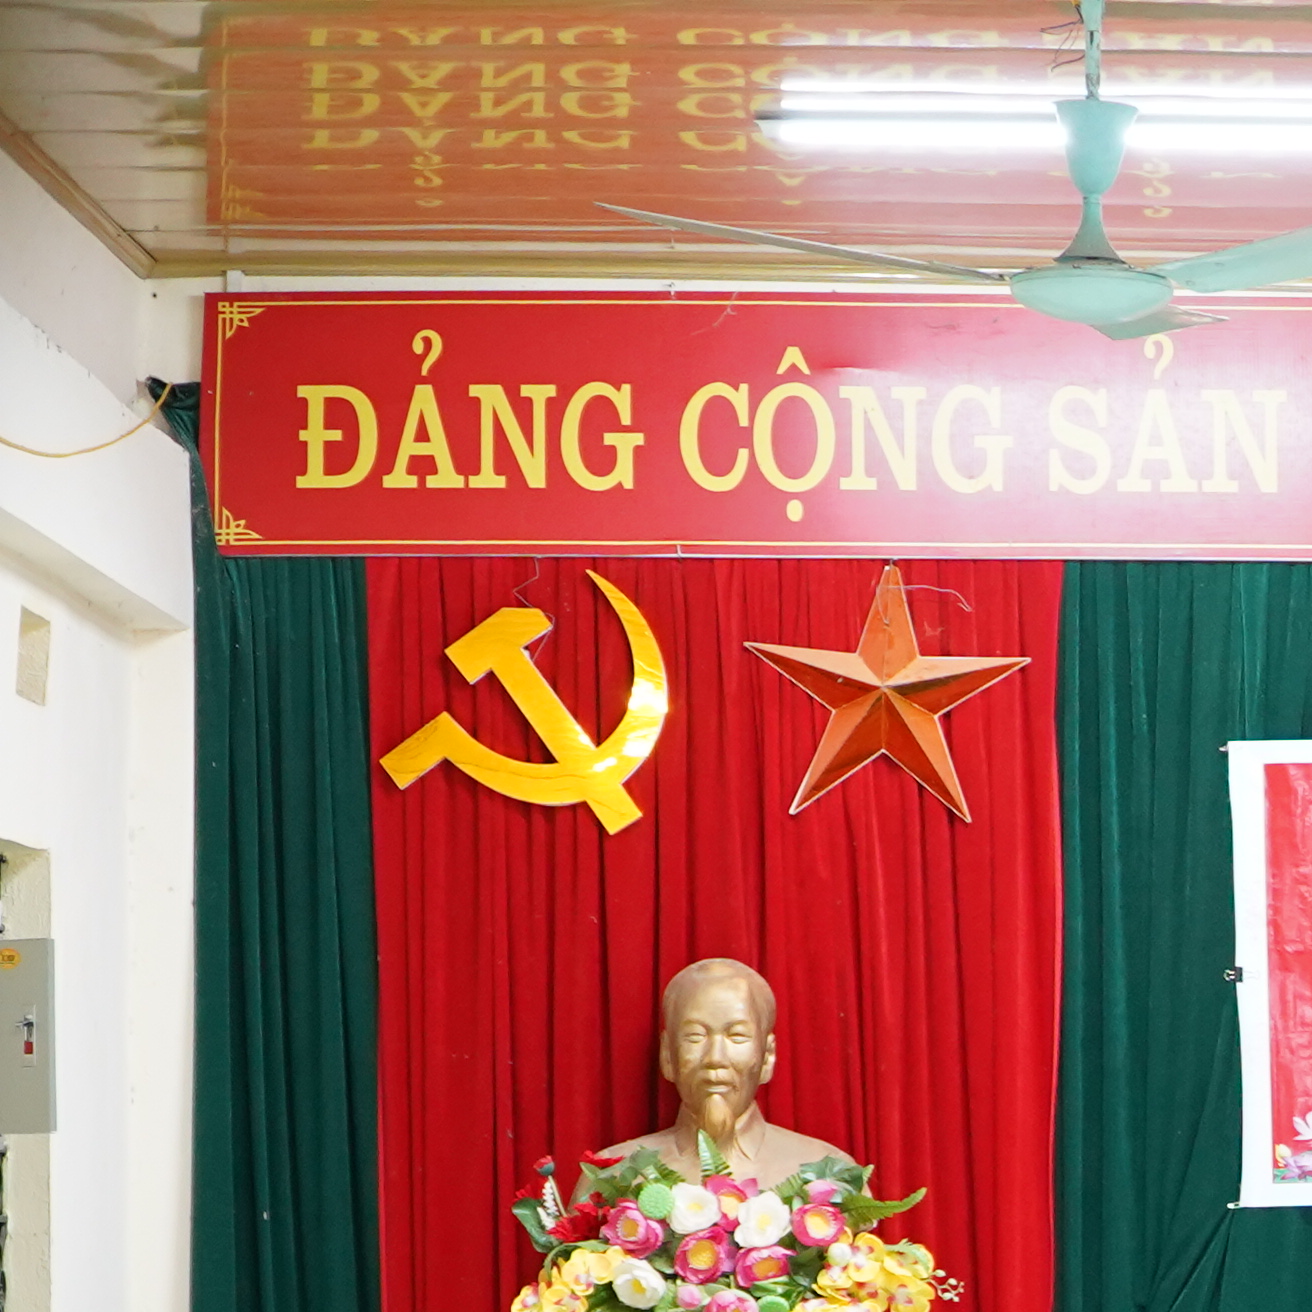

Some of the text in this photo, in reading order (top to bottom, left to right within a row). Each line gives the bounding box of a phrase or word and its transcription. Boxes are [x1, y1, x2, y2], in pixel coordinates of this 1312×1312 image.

[295, 329, 644, 492] ĐẢNG
[679, 346, 1014, 523] CỘNG
[1047, 334, 1287, 495] SẢN
